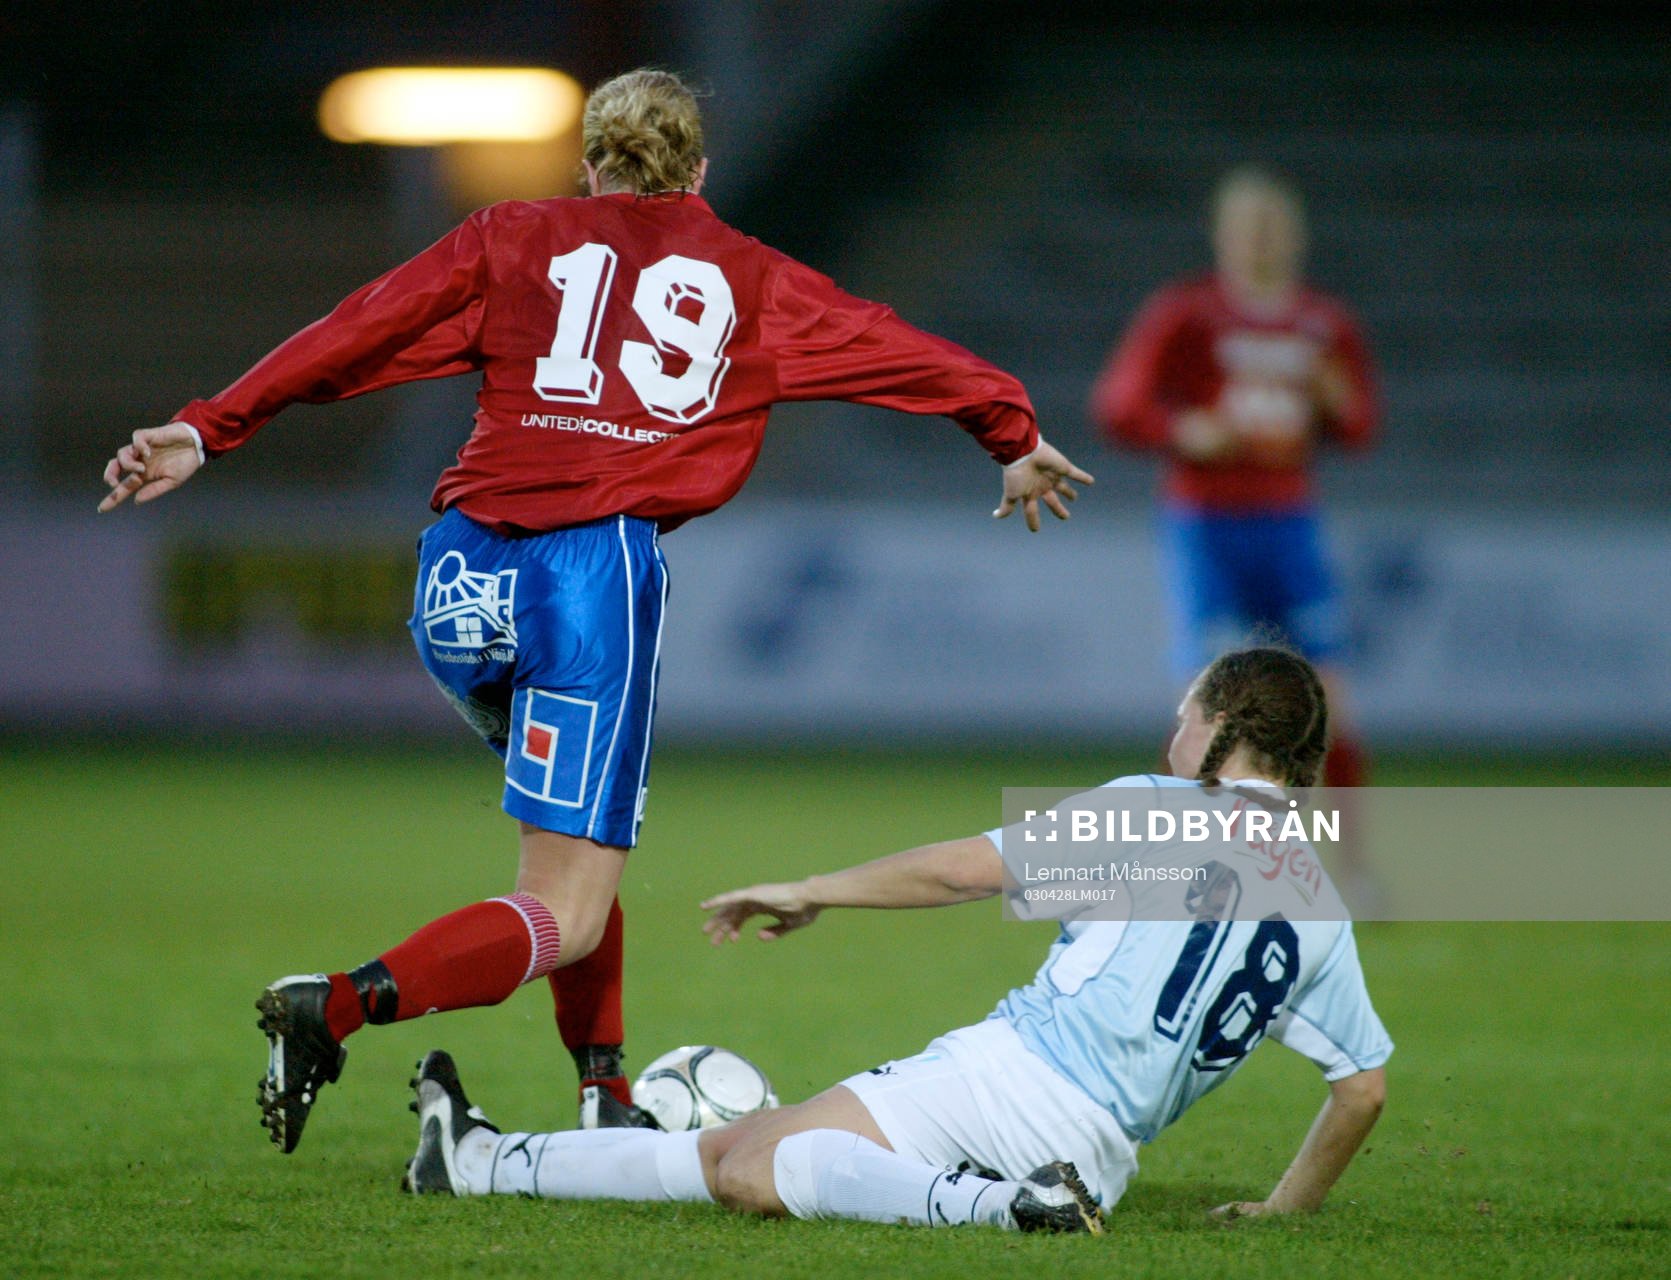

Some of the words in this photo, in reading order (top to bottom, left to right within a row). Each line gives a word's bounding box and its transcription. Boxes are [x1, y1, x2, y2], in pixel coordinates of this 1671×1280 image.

[521, 413, 580, 432] UNITED
[532, 242, 737, 424] 19
[1153, 859, 1300, 1072] 18
